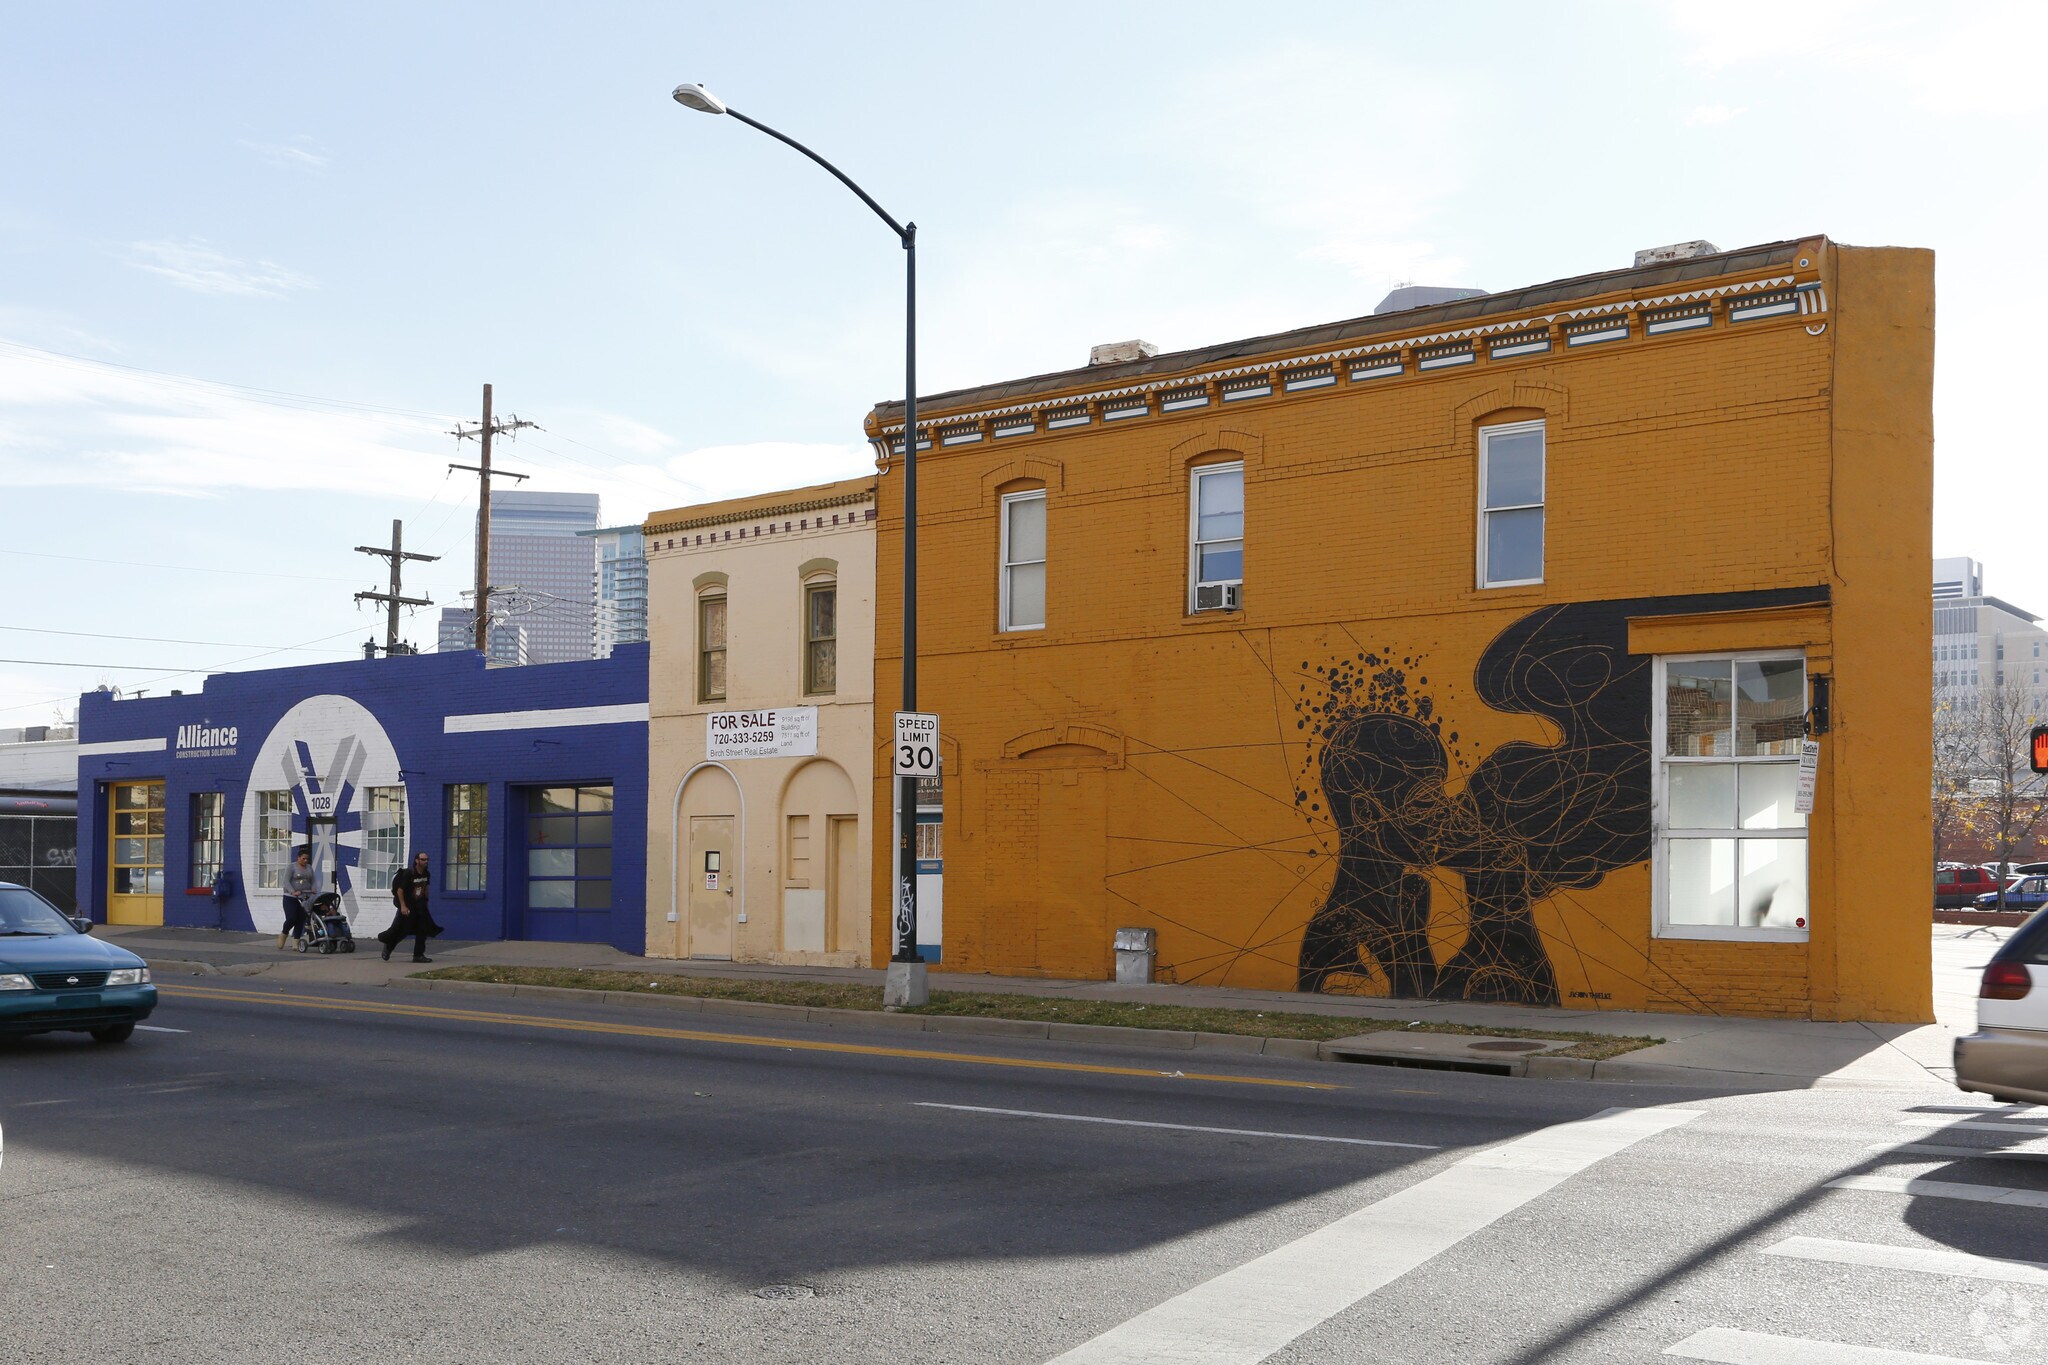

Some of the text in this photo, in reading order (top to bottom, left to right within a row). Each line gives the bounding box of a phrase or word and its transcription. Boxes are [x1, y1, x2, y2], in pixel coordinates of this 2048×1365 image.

[712, 713, 775, 729] FOR SALE
[898, 719, 934, 729] SPEED
[176, 724, 238, 749] Alliance
[714, 731, 773, 744] 720-333-5259
[902, 732, 930, 742] LIMIT
[176, 748, 237, 758] CONSTRUCTION SOLUTIONS
[710, 747, 778, 757] Birch Street Real Estate
[899, 745, 934, 769] 30
[920, 778, 941, 787] 1030
[312, 797, 330, 809] 1028
